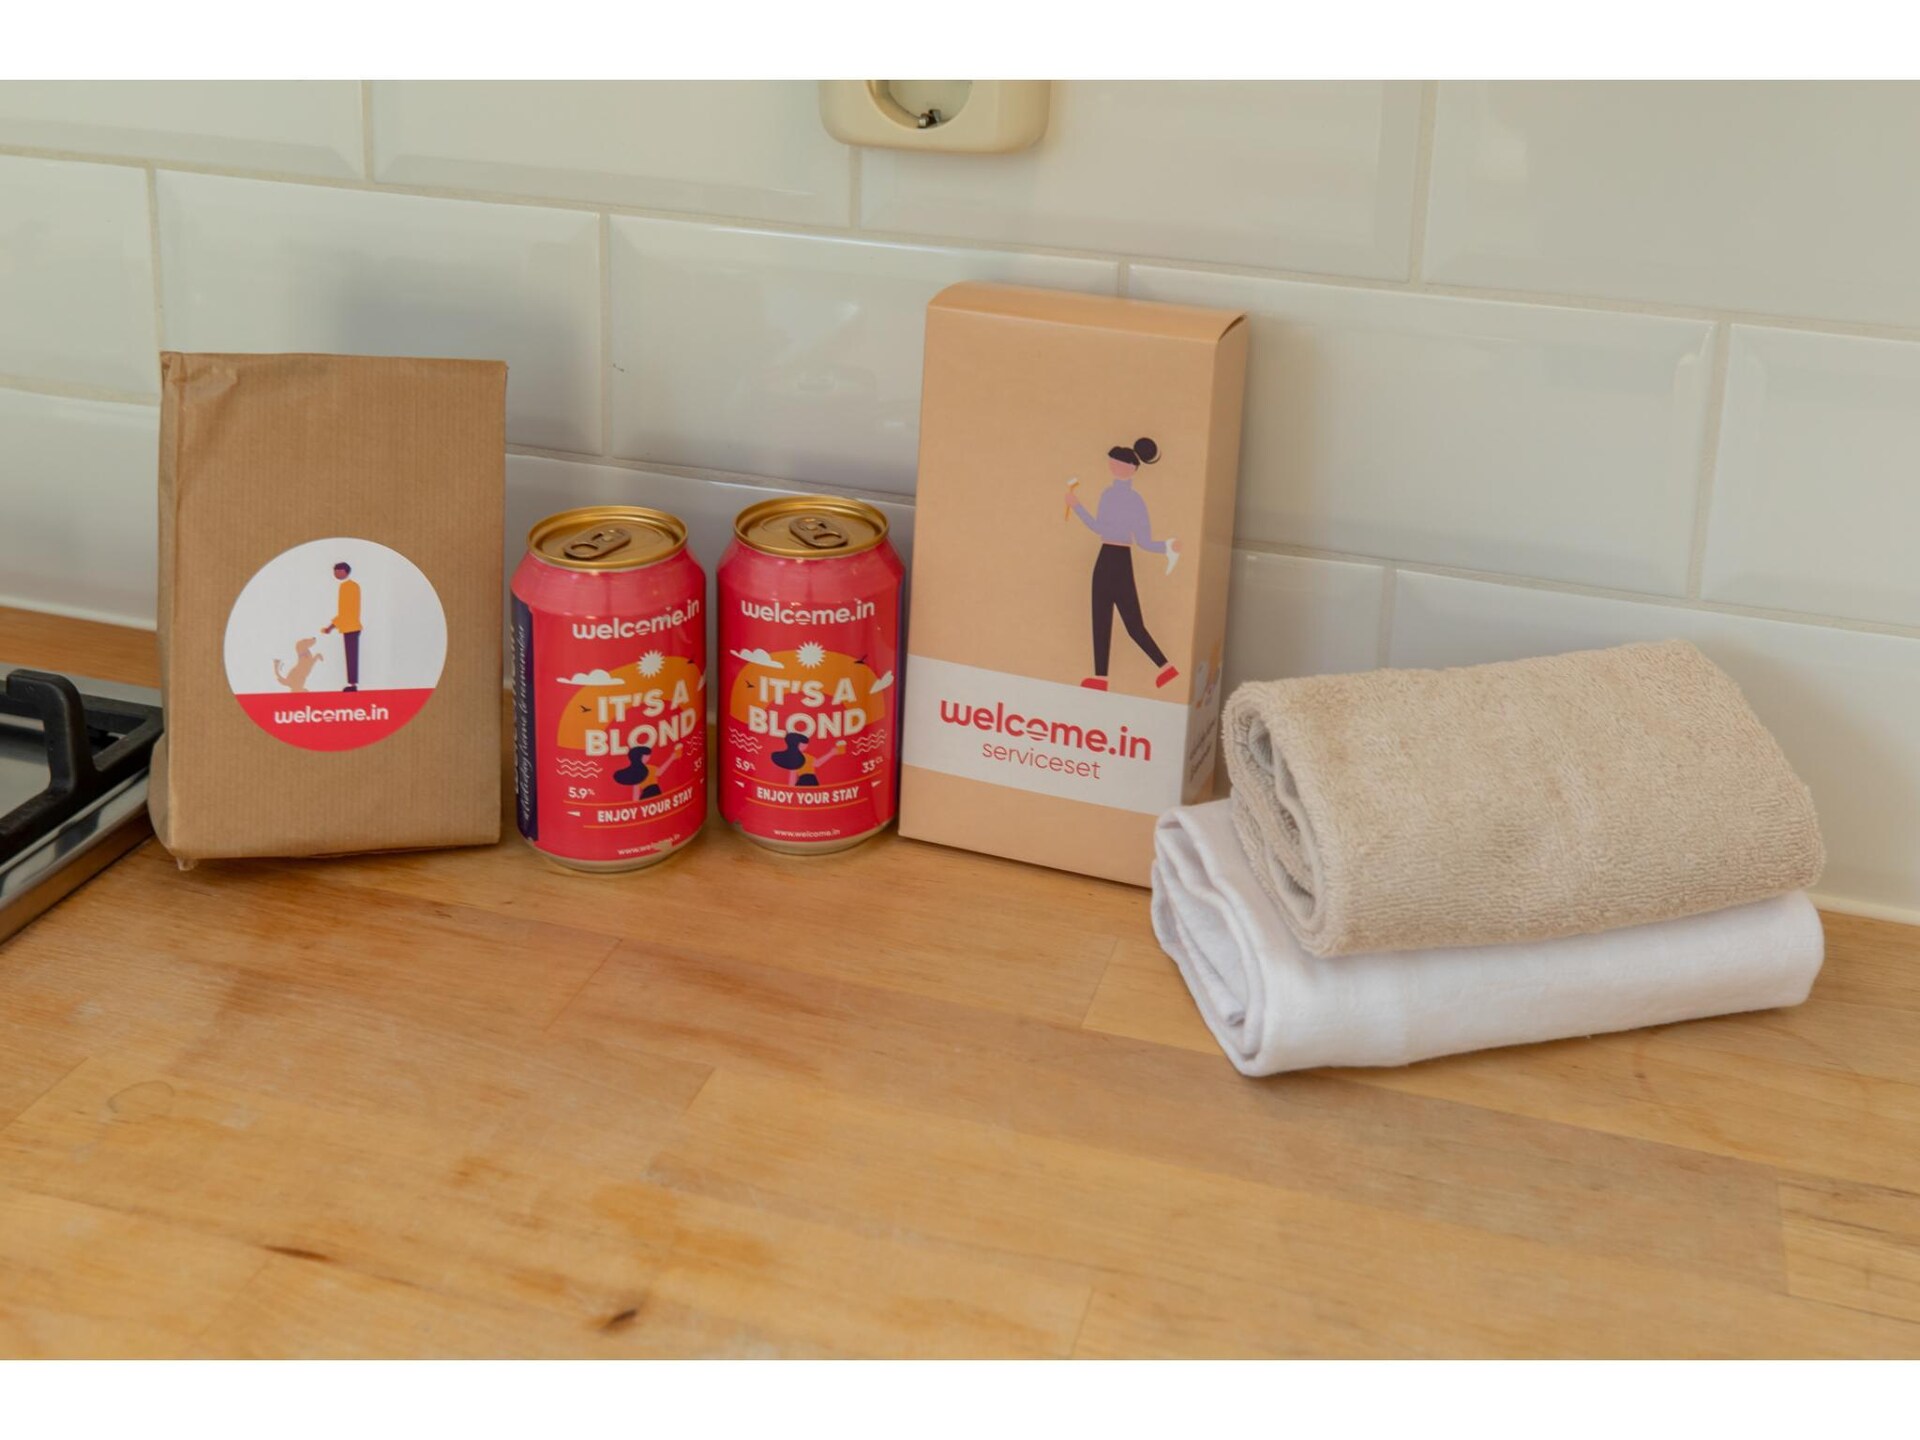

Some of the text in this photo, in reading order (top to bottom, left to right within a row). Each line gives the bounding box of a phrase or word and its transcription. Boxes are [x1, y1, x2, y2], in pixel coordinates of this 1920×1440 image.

[572, 599, 700, 640] welcome.in
[741, 600, 875, 625] welcome.in
[597, 679, 690, 724] IT'S A
[758, 676, 857, 708] IT'S A
[275, 703, 389, 724] welcome.in
[748, 705, 867, 740] BLOND
[940, 699, 1153, 761] welcome.in
[585, 707, 698, 757] BLOND
[982, 741, 1101, 780] serviceset
[597, 786, 694, 824] ENJOY YOUR STAY
[756, 786, 860, 805] ENJOY YOUR STAY
[773, 828, 841, 839] www.welcome.in
